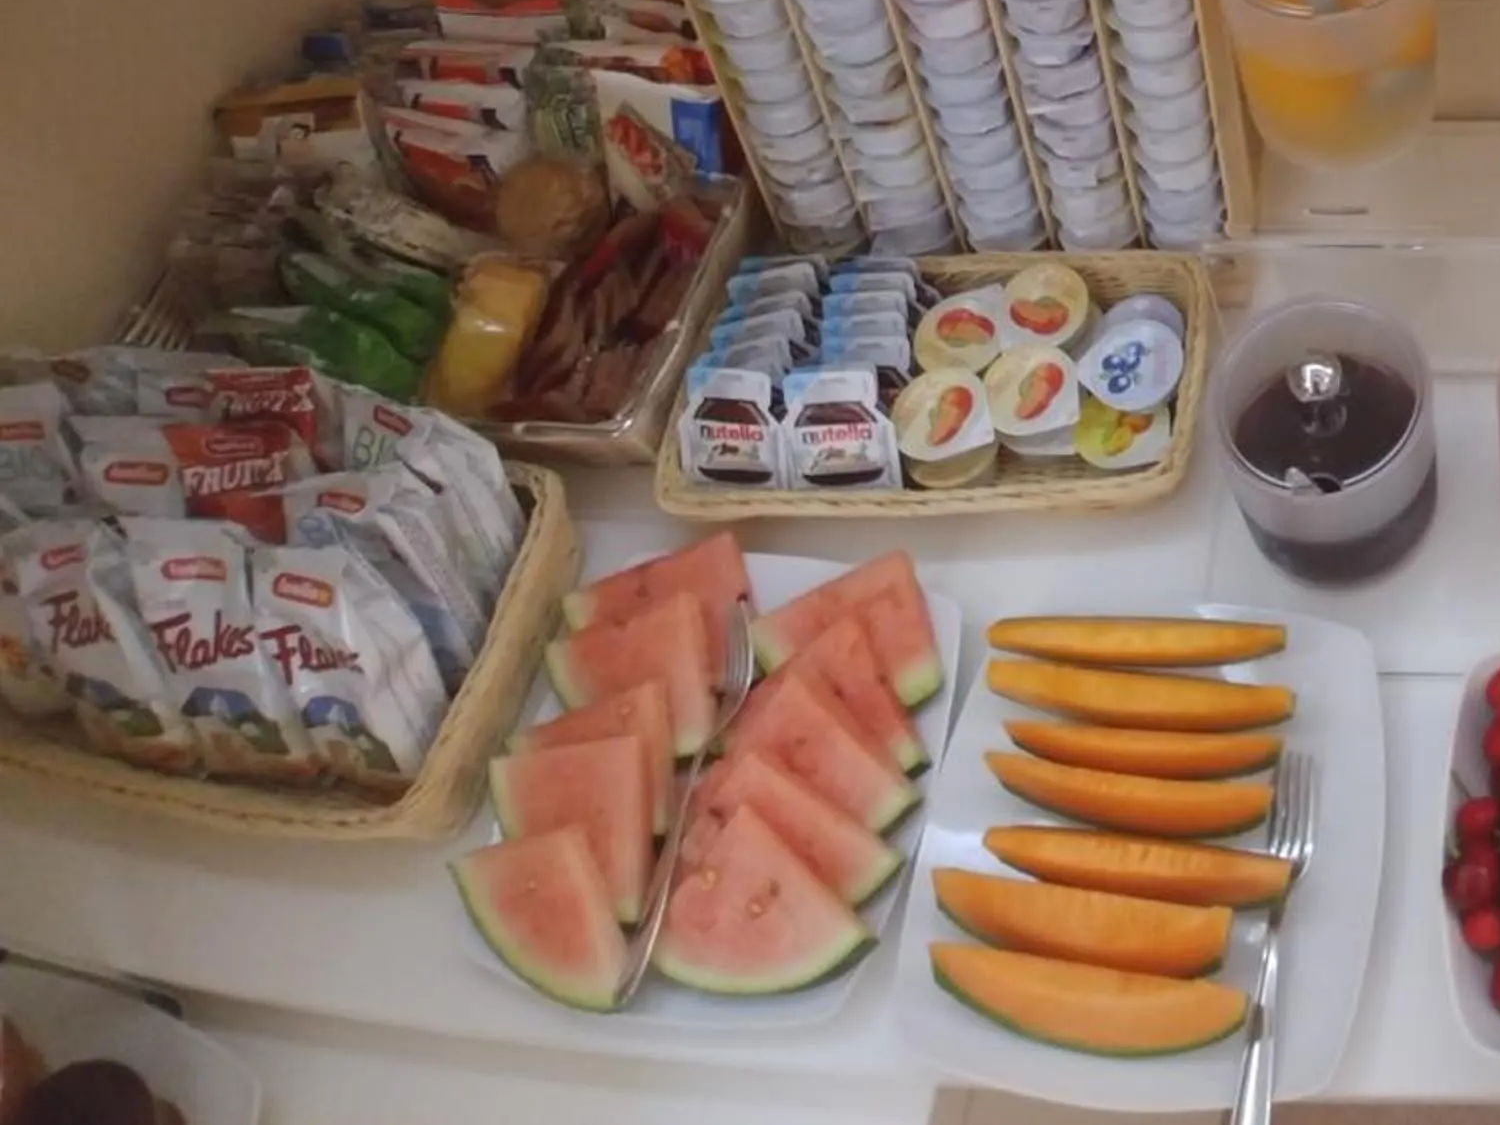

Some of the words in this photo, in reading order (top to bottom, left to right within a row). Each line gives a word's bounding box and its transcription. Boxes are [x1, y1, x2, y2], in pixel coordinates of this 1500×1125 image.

[700, 424, 764, 443] nutella
[802, 421, 873, 444] nutella
[150, 610, 255, 673] Flakes
